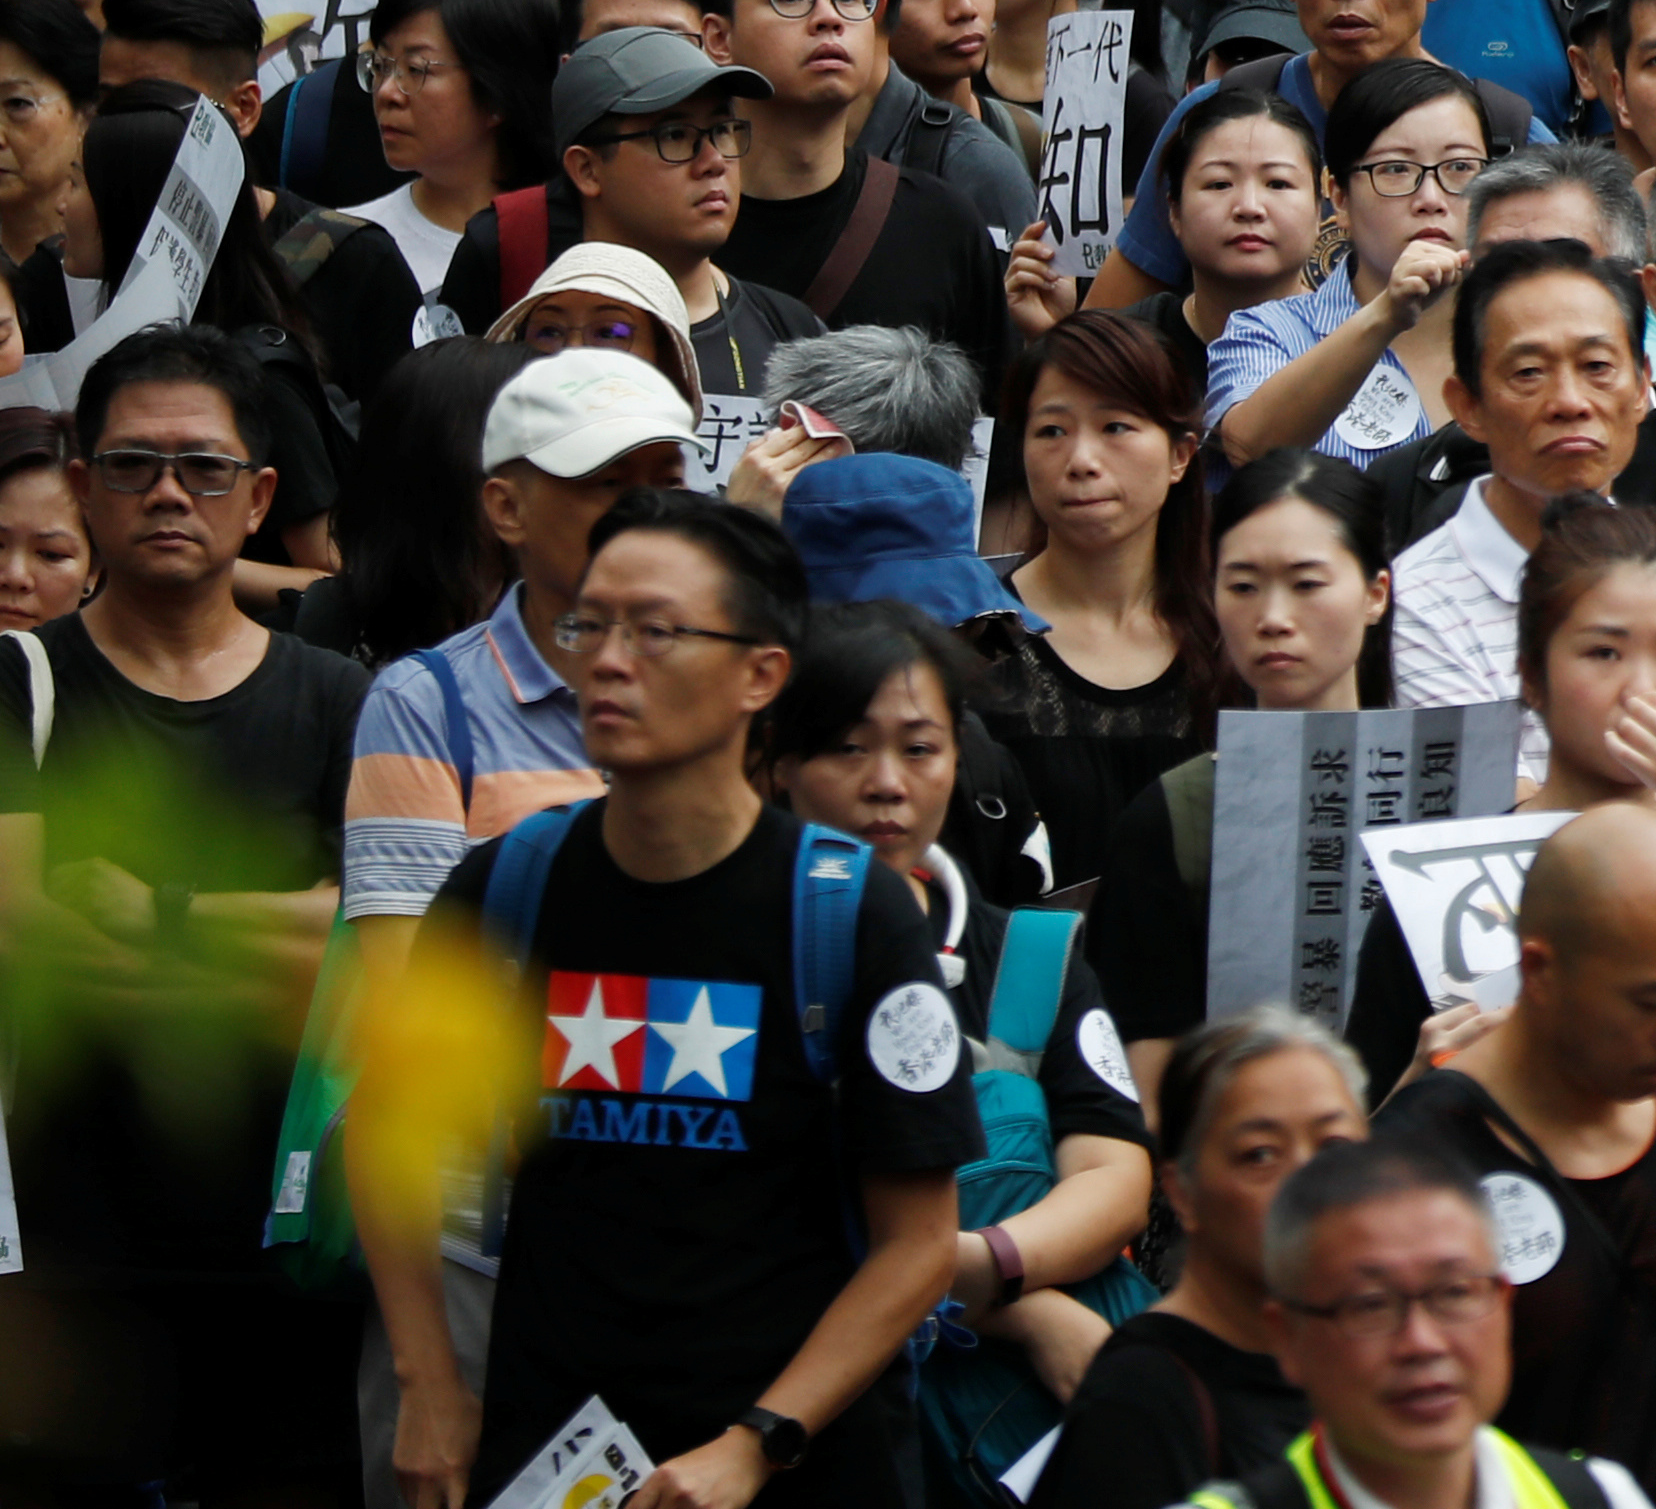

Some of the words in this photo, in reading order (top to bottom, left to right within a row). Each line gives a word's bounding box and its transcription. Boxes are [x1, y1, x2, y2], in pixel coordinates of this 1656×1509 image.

[1304, 747, 1348, 919] 回應訴求
[536, 1097, 750, 1153] TAMIYA
